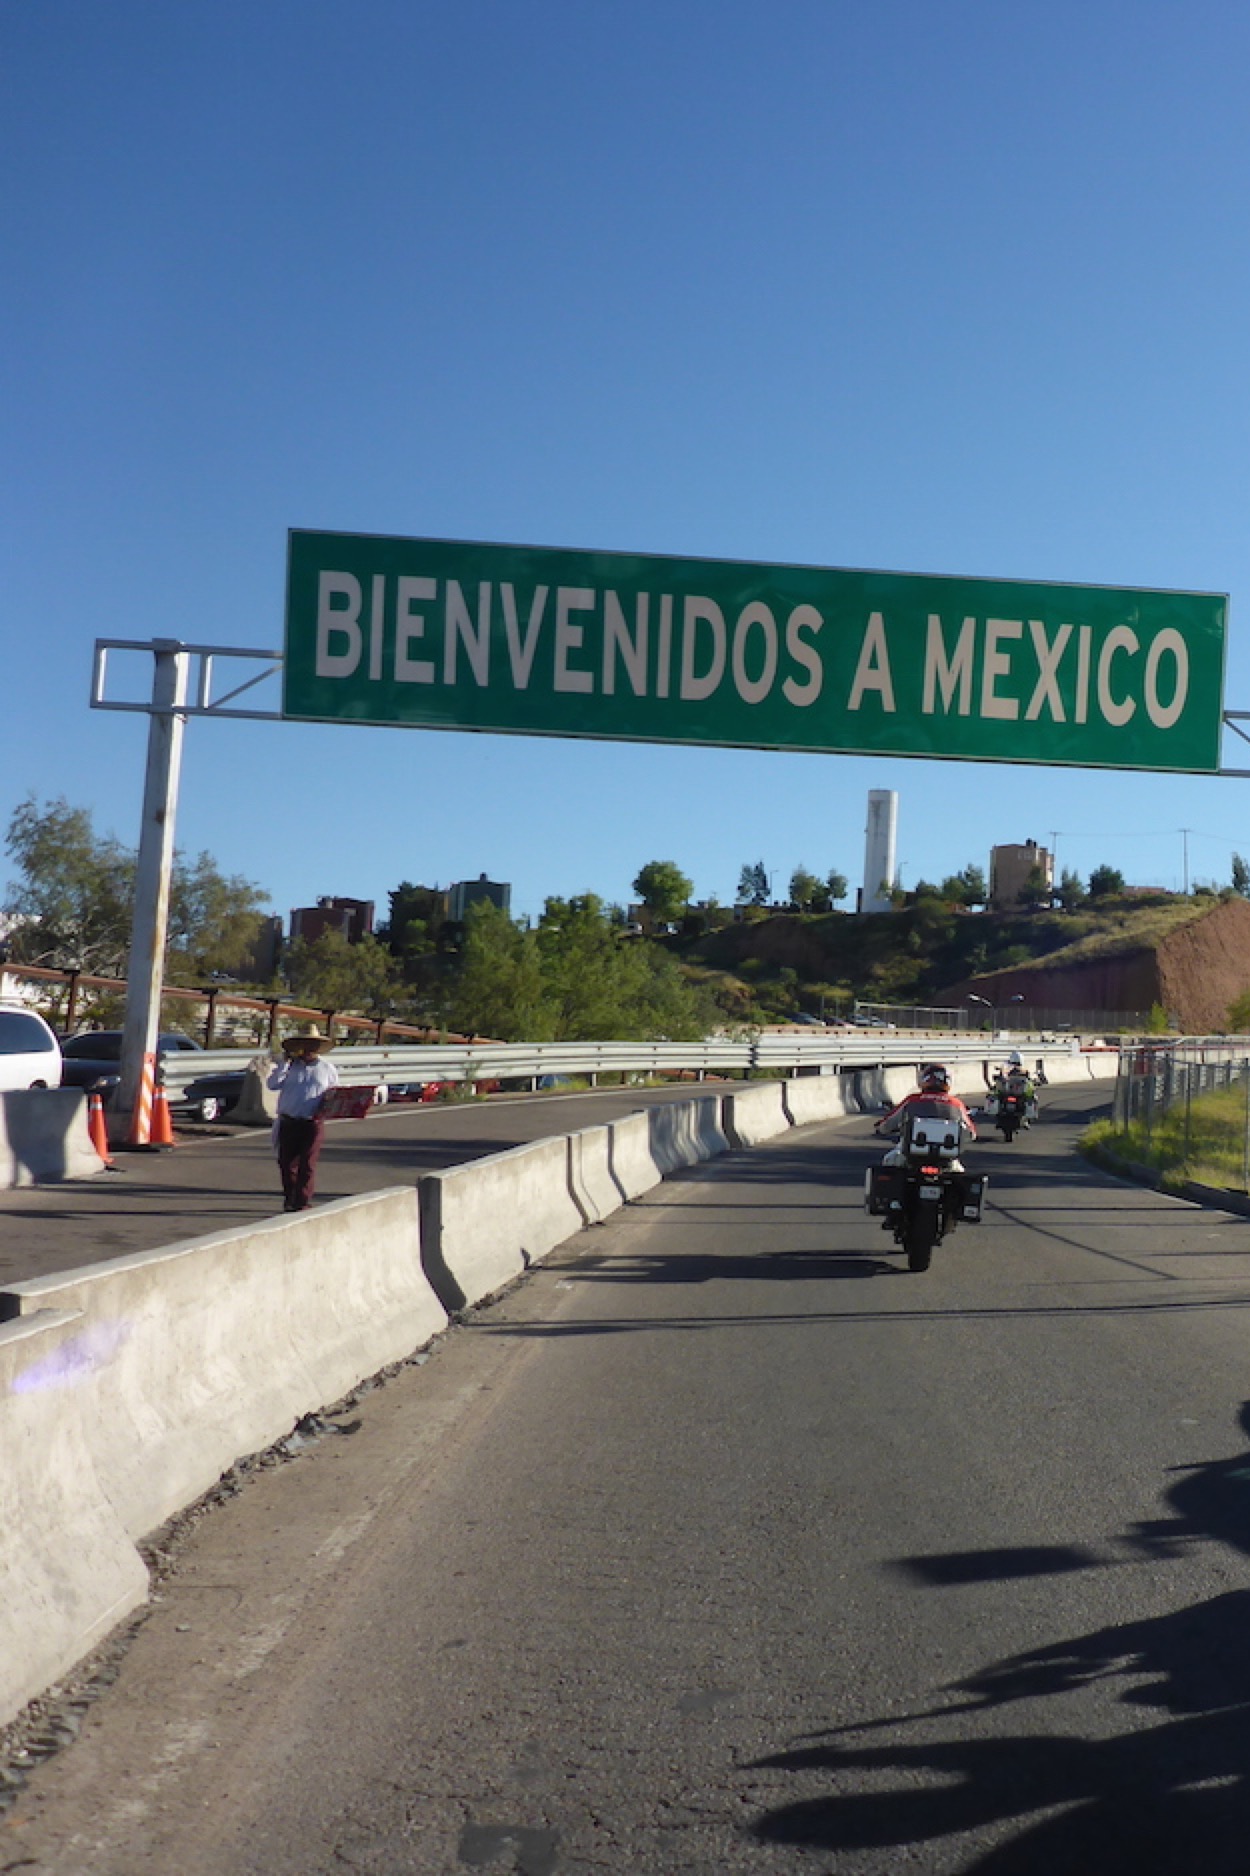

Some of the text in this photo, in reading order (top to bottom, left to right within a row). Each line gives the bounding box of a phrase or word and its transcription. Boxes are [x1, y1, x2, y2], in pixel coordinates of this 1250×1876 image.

[314, 569, 1189, 729] BIENVENIDOS A MEXICO
